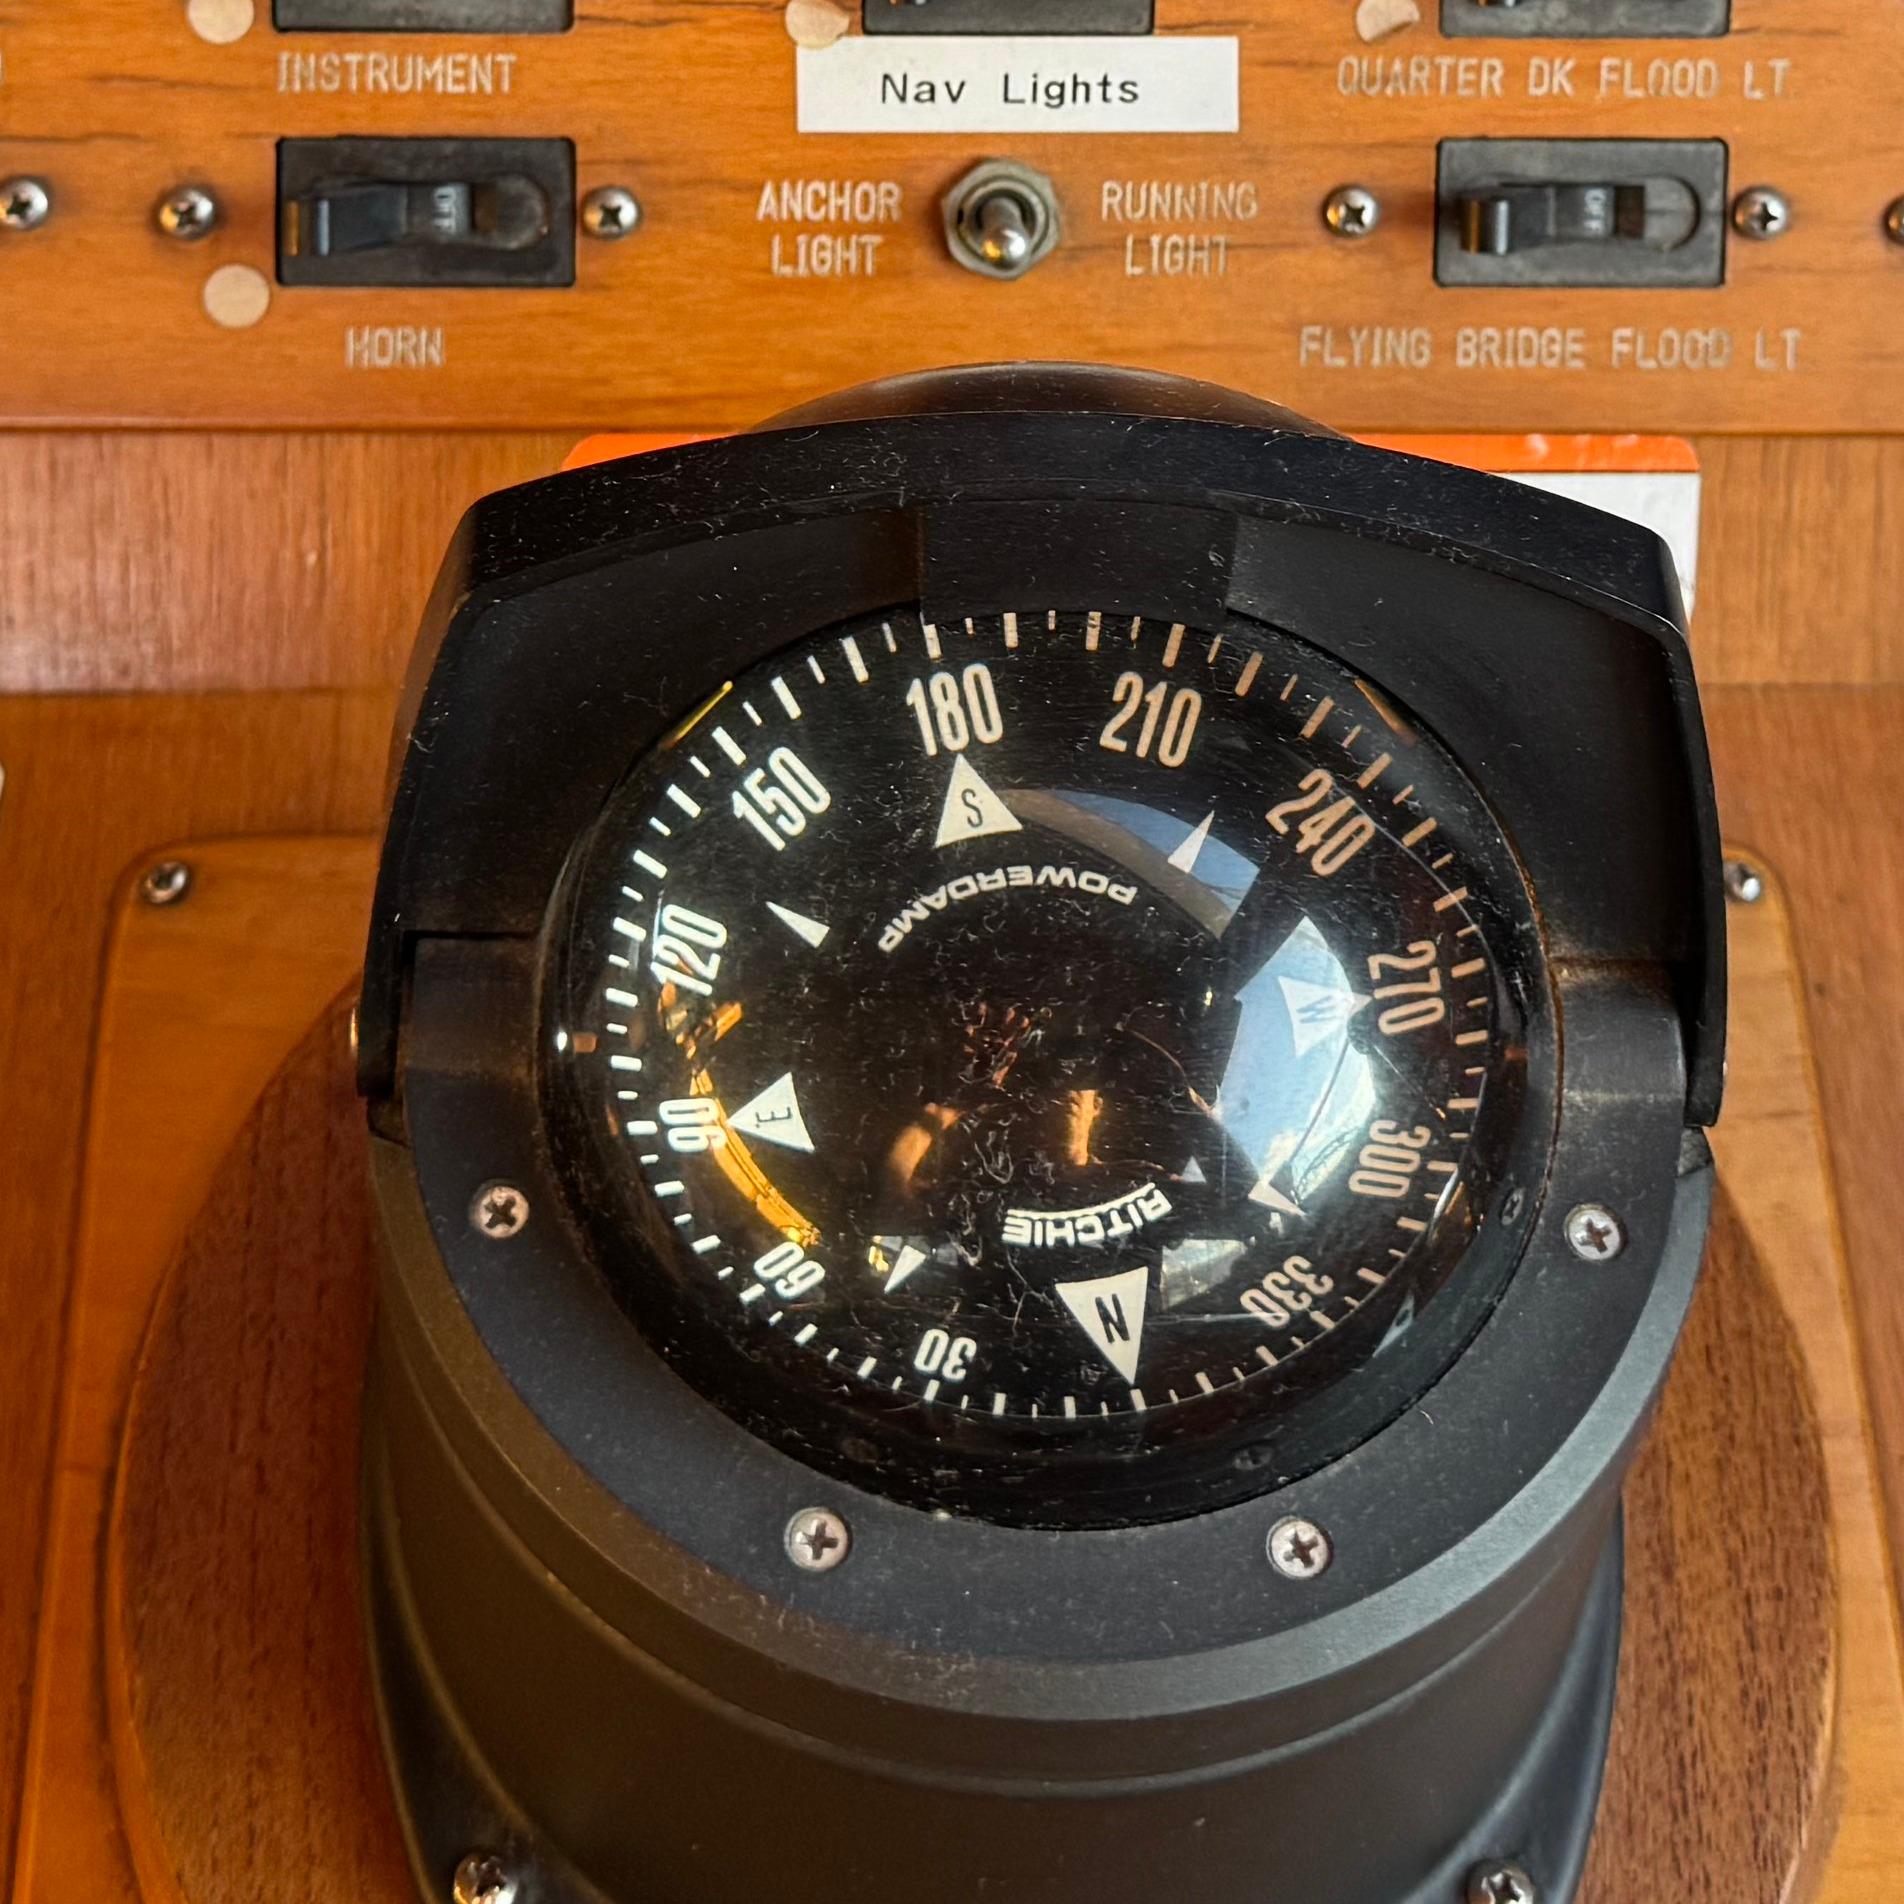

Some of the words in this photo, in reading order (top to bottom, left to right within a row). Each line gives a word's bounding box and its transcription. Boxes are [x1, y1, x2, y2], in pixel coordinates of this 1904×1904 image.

[277, 52, 518, 96] INSTRUMENT
[881, 73, 965, 105] Nav
[1001, 71, 1140, 112] Lights
[1336, 56, 1504, 97] QUARTER
[1527, 57, 1575, 97] DK
[1598, 59, 1720, 98] FLOOD
[1742, 60, 1790, 99] LT
[756, 181, 903, 222] ANCHOR
[1099, 181, 1258, 222] RUNNING
[770, 235, 884, 277] LIGHT
[1122, 235, 1230, 277] LIGHT
[344, 327, 444, 368] HORN
[1299, 327, 1432, 369] FLYING
[1454, 327, 1586, 368] BRIDGE
[1610, 328, 1732, 369] FLOOD
[1755, 328, 1801, 369] LT
[906, 663, 1005, 756] 180
[1099, 671, 1202, 768] 210
[731, 745, 830, 852] 150
[962, 787, 983, 828] S
[1264, 767, 1375, 878] 240
[877, 862, 1139, 954] POWERDAMP
[652, 903, 727, 996] 120
[1367, 939, 1444, 1037] 270
[658, 1095, 726, 1152] 90
[755, 1103, 793, 1129] E
[1350, 1118, 1431, 1198] 300
[1005, 1182, 1174, 1247] RITCHIE
[753, 1238, 825, 1298] 60
[1240, 1255, 1334, 1329] 330
[1095, 1292, 1131, 1344] N
[914, 1328, 978, 1382] 30
